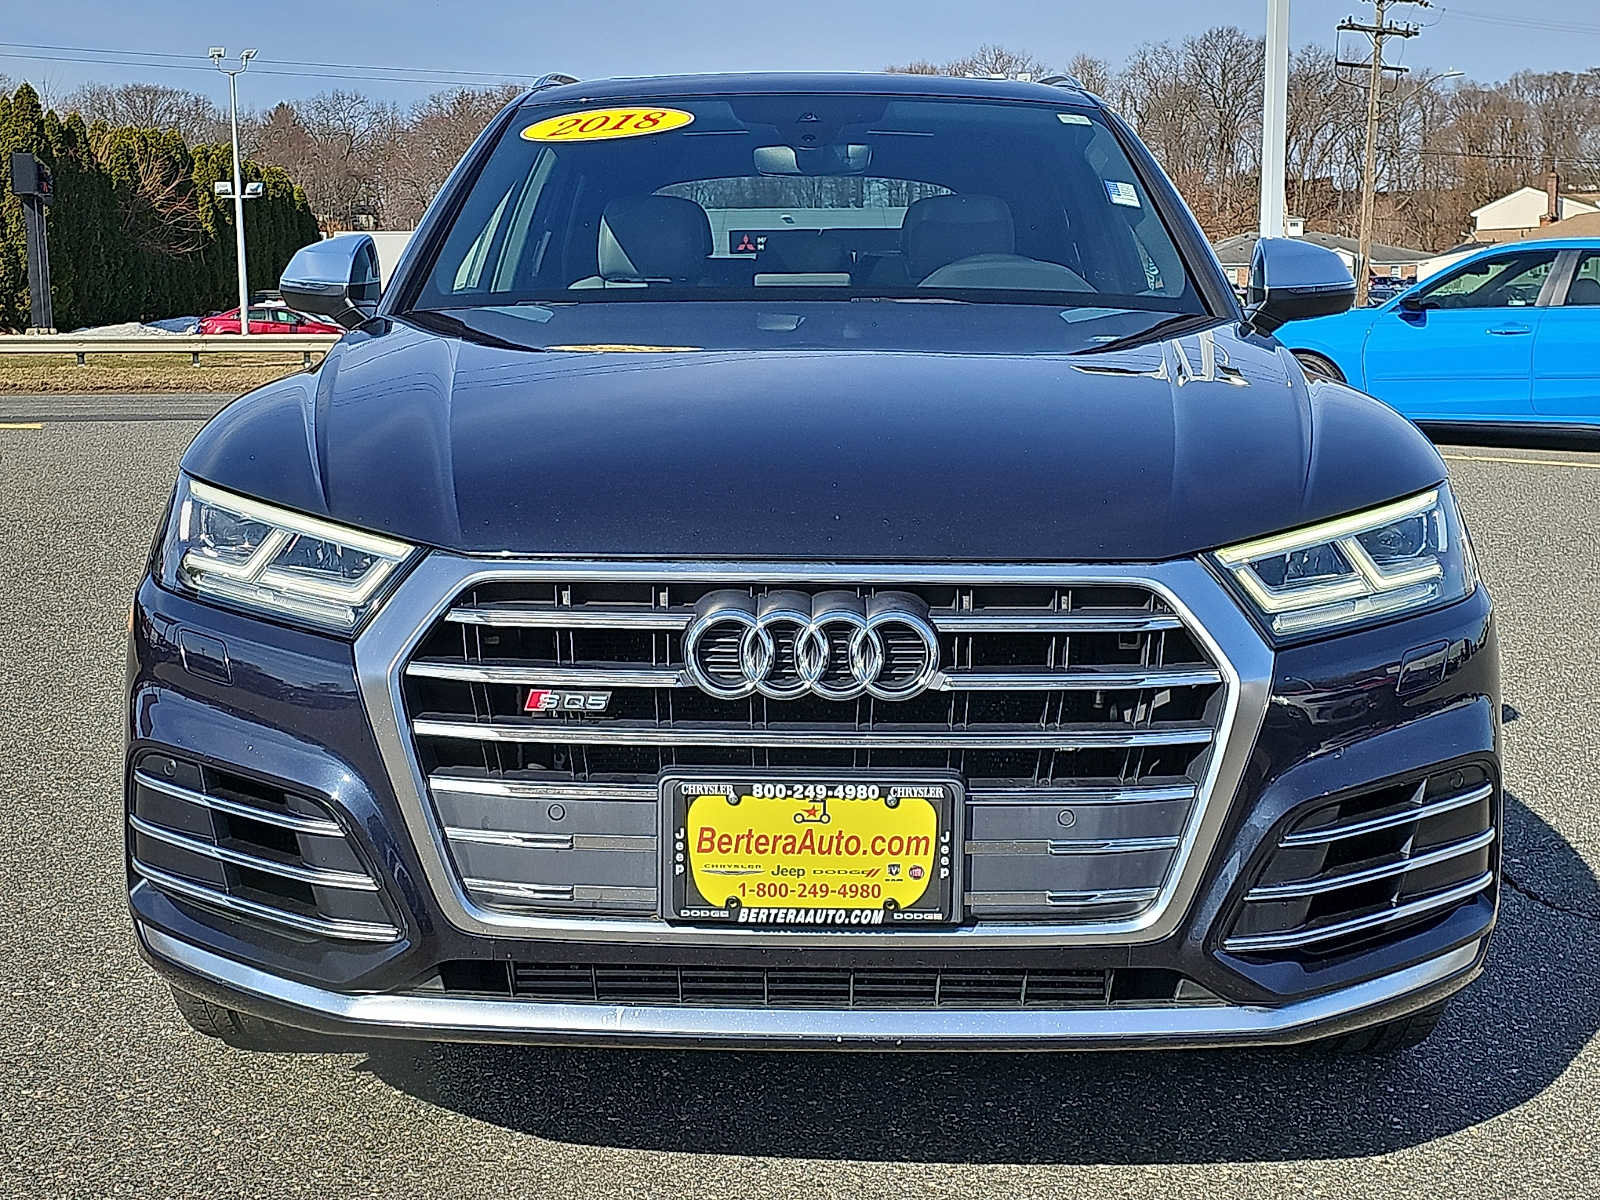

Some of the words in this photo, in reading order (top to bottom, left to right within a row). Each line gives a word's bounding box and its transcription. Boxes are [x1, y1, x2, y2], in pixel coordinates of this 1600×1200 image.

[547, 111, 667, 137] 2018
[535, 692, 609, 710] SQ5
[681, 784, 734, 795] CHRYSLER
[752, 784, 879, 799] 800-249-4980
[890, 787, 944, 798] CHRYSLER
[697, 827, 930, 856] BerteraAuto.com
[675, 828, 685, 876] Jeep
[940, 831, 950, 879] Jeep
[771, 864, 806, 878] Jeep
[738, 883, 882, 899] 1-800-249-4980
[680, 909, 729, 918] DODGE
[738, 908, 884, 925] BERTERAAUTO.COM
[894, 912, 943, 920] DODGE
